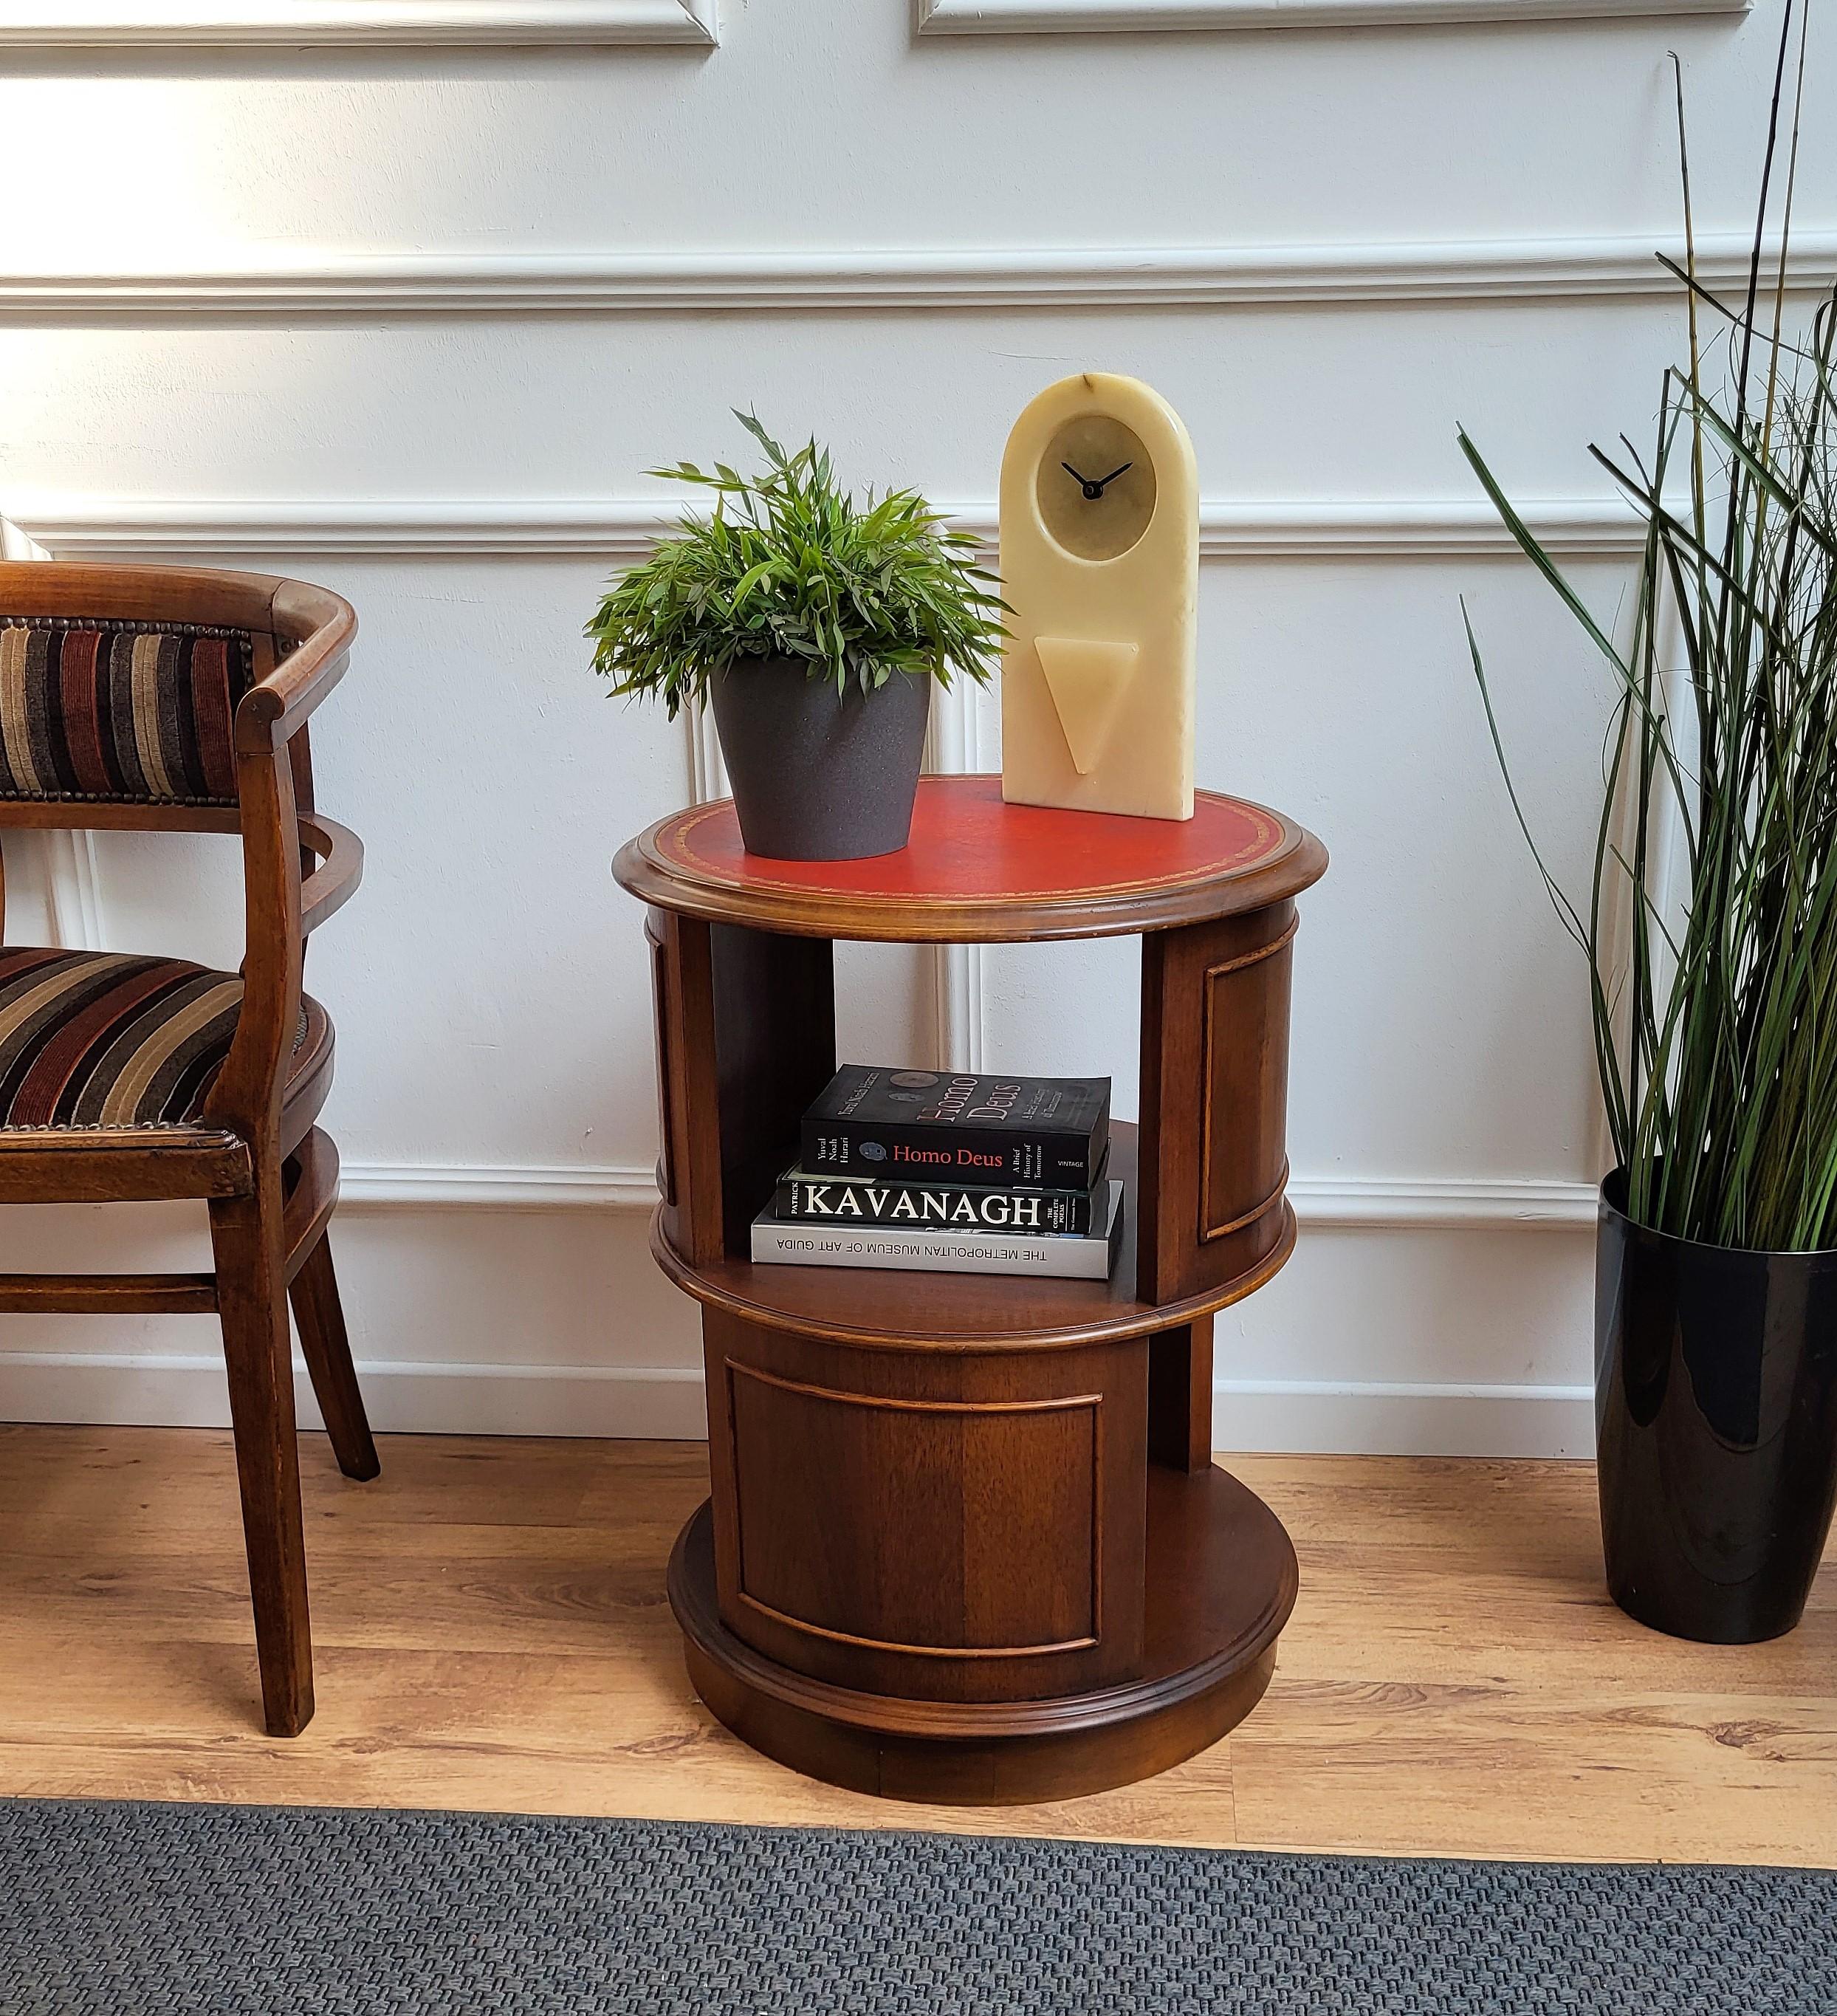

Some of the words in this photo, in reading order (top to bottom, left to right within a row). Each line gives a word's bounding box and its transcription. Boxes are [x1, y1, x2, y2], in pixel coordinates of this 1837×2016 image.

[916, 1077, 978, 1122] Homo
[966, 1085, 1021, 1121] Deus
[817, 1138, 826, 1160] Yuval
[829, 1139, 837, 1161] Noah
[840, 1137, 848, 1163] Harari
[893, 1145, 952, 1164] Homo
[956, 1149, 1003, 1167] Deus
[1012, 1148, 1020, 1165] Brief
[1023, 1143, 1031, 1152] of
[1023, 1153, 1033, 1178] History
[791, 1182, 799, 1215] PATRICK
[804, 1185, 1042, 1226] KAVANAGH
[777, 1238, 814, 1251] GUIDA
[818, 1241, 842, 1252] ART
[846, 1242, 863, 1252] OF
[867, 1243, 920, 1255] MUSEUM
[924, 1246, 1018, 1260] METROPOLITAN
[1023, 1249, 1048, 1261] THE
